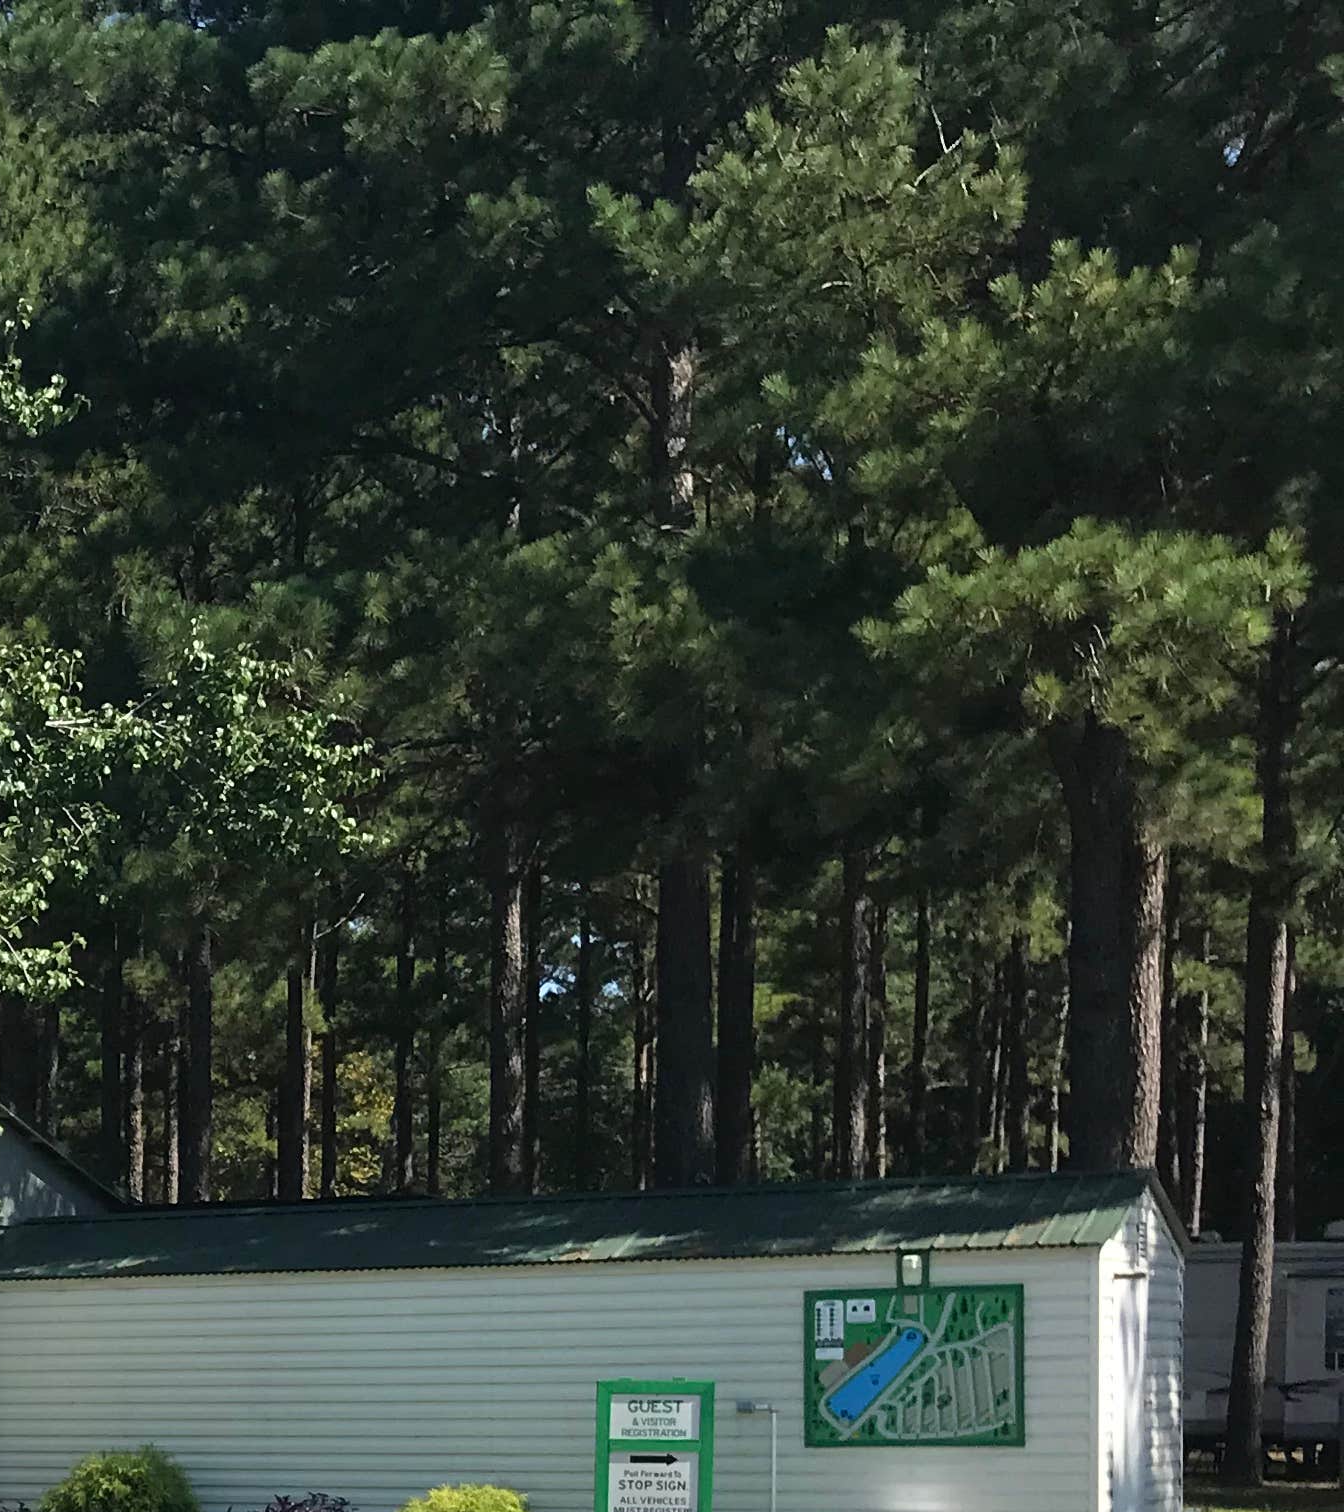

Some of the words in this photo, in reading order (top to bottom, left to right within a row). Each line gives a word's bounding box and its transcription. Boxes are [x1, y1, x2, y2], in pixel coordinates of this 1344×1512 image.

[627, 1399, 683, 1413] GUEST
[632, 1417, 639, 1426] &
[641, 1417, 676, 1426] VISITOR
[621, 1428, 687, 1437] REGISTRATION
[618, 1480, 652, 1490] STOP
[656, 1480, 686, 1491] SIGN
[620, 1496, 637, 1505] ALL
[640, 1496, 686, 1505] VEHICLES
